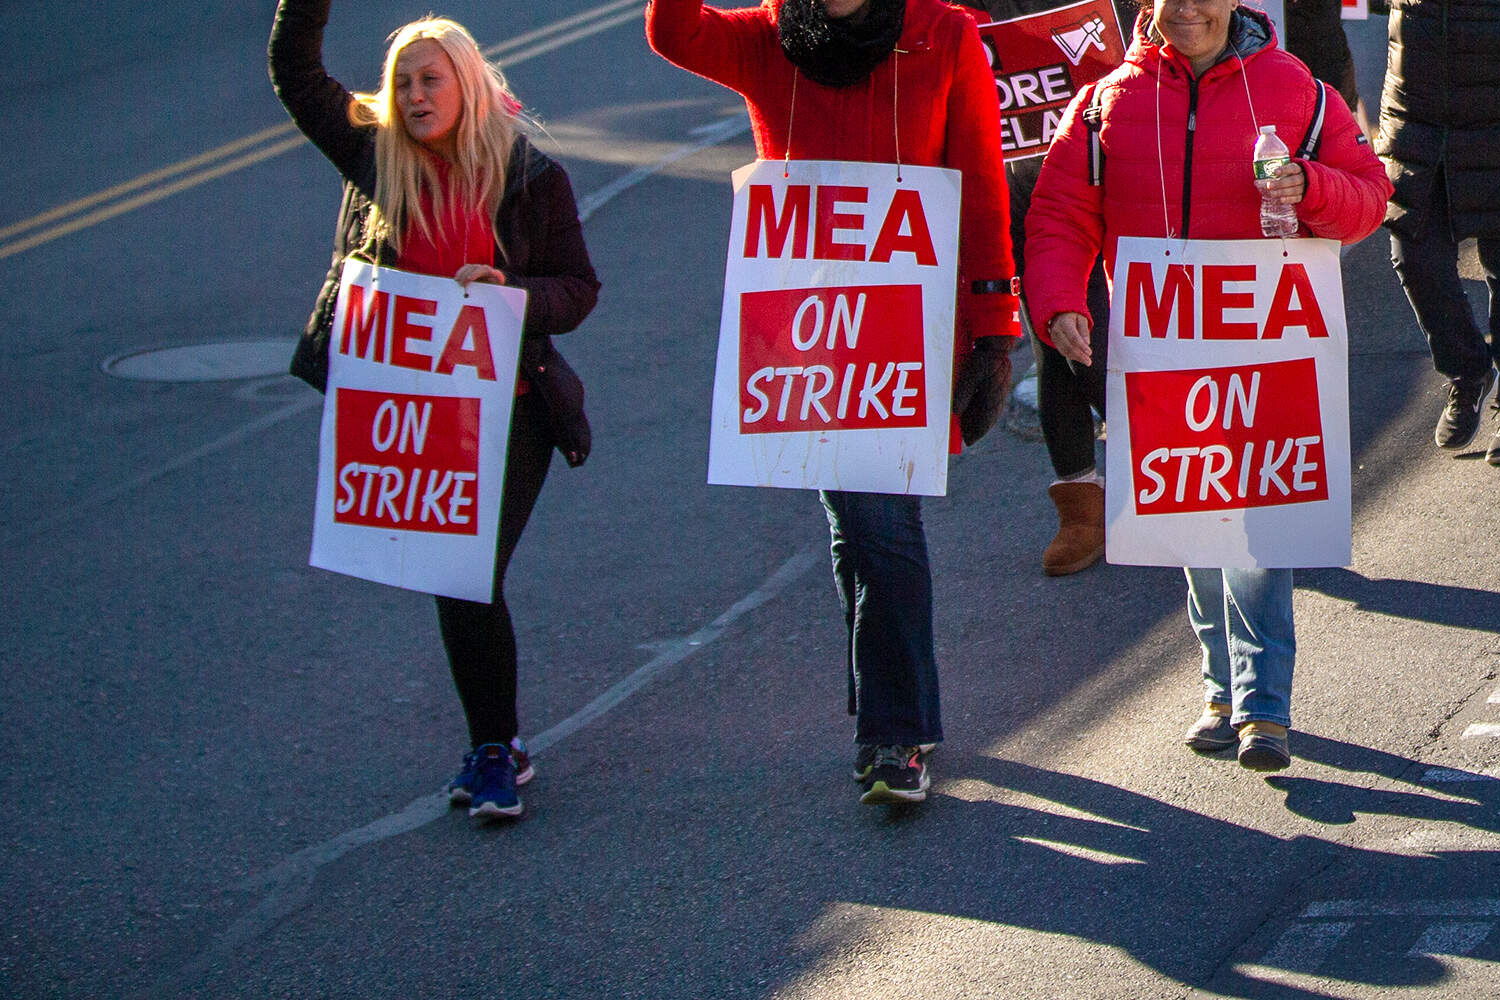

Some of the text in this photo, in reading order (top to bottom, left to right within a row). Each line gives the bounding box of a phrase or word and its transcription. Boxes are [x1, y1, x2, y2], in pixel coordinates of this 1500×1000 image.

[994, 66, 1072, 110] ORE
[743, 184, 939, 266] MEA
[791, 293, 866, 351] ON
[1123, 261, 1330, 340] MEA
[338, 283, 497, 382] MEA
[743, 361, 922, 423] STRIKE
[1184, 370, 1261, 432] ON
[371, 399, 433, 455] ON
[335, 461, 477, 526] STRIKE
[1139, 435, 1320, 504] STRIKE
